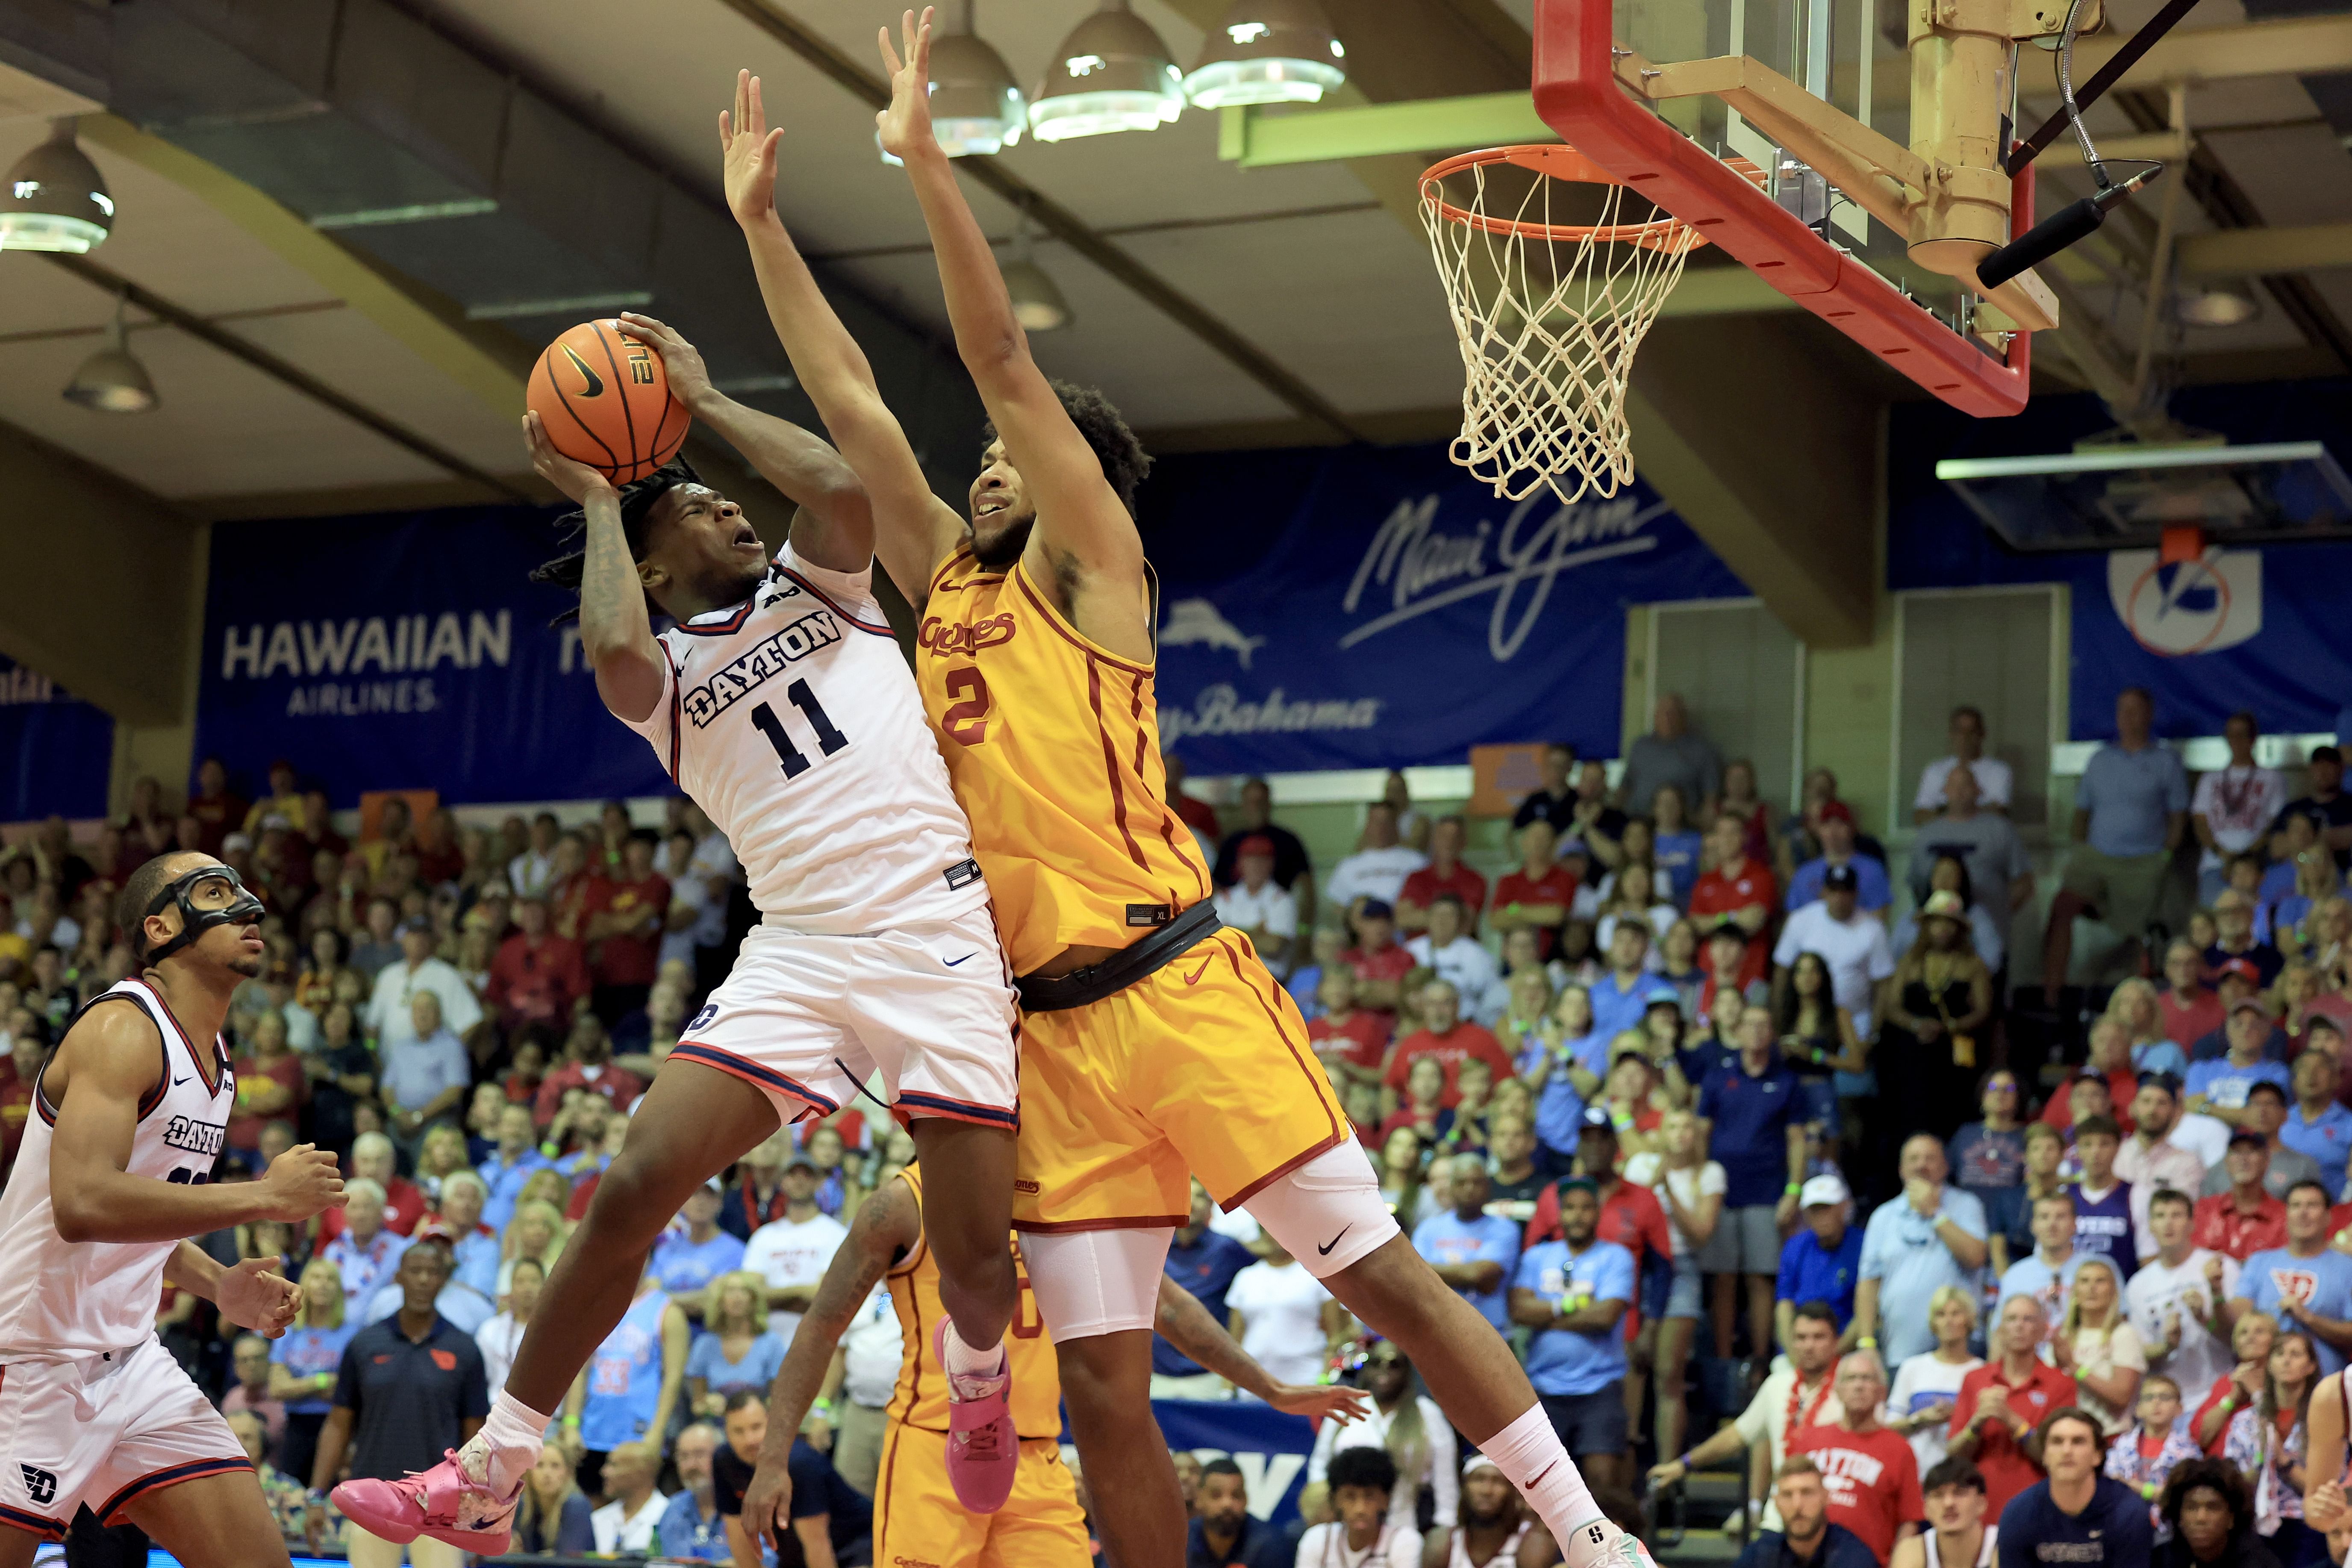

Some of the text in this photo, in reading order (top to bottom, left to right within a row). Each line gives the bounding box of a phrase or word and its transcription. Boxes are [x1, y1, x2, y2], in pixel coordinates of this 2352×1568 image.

[1342, 491, 1492, 615] Maui
[221, 608, 512, 680] HAWAIIAN
[683, 611, 842, 729] DAYTON
[286, 677, 437, 717] AIRLINES
[751, 677, 849, 781] 11
[942, 666, 990, 747] 2
[1190, 680, 1378, 737] Bahama
[971, 863, 979, 874] M
[1157, 912, 1166, 920] XL
